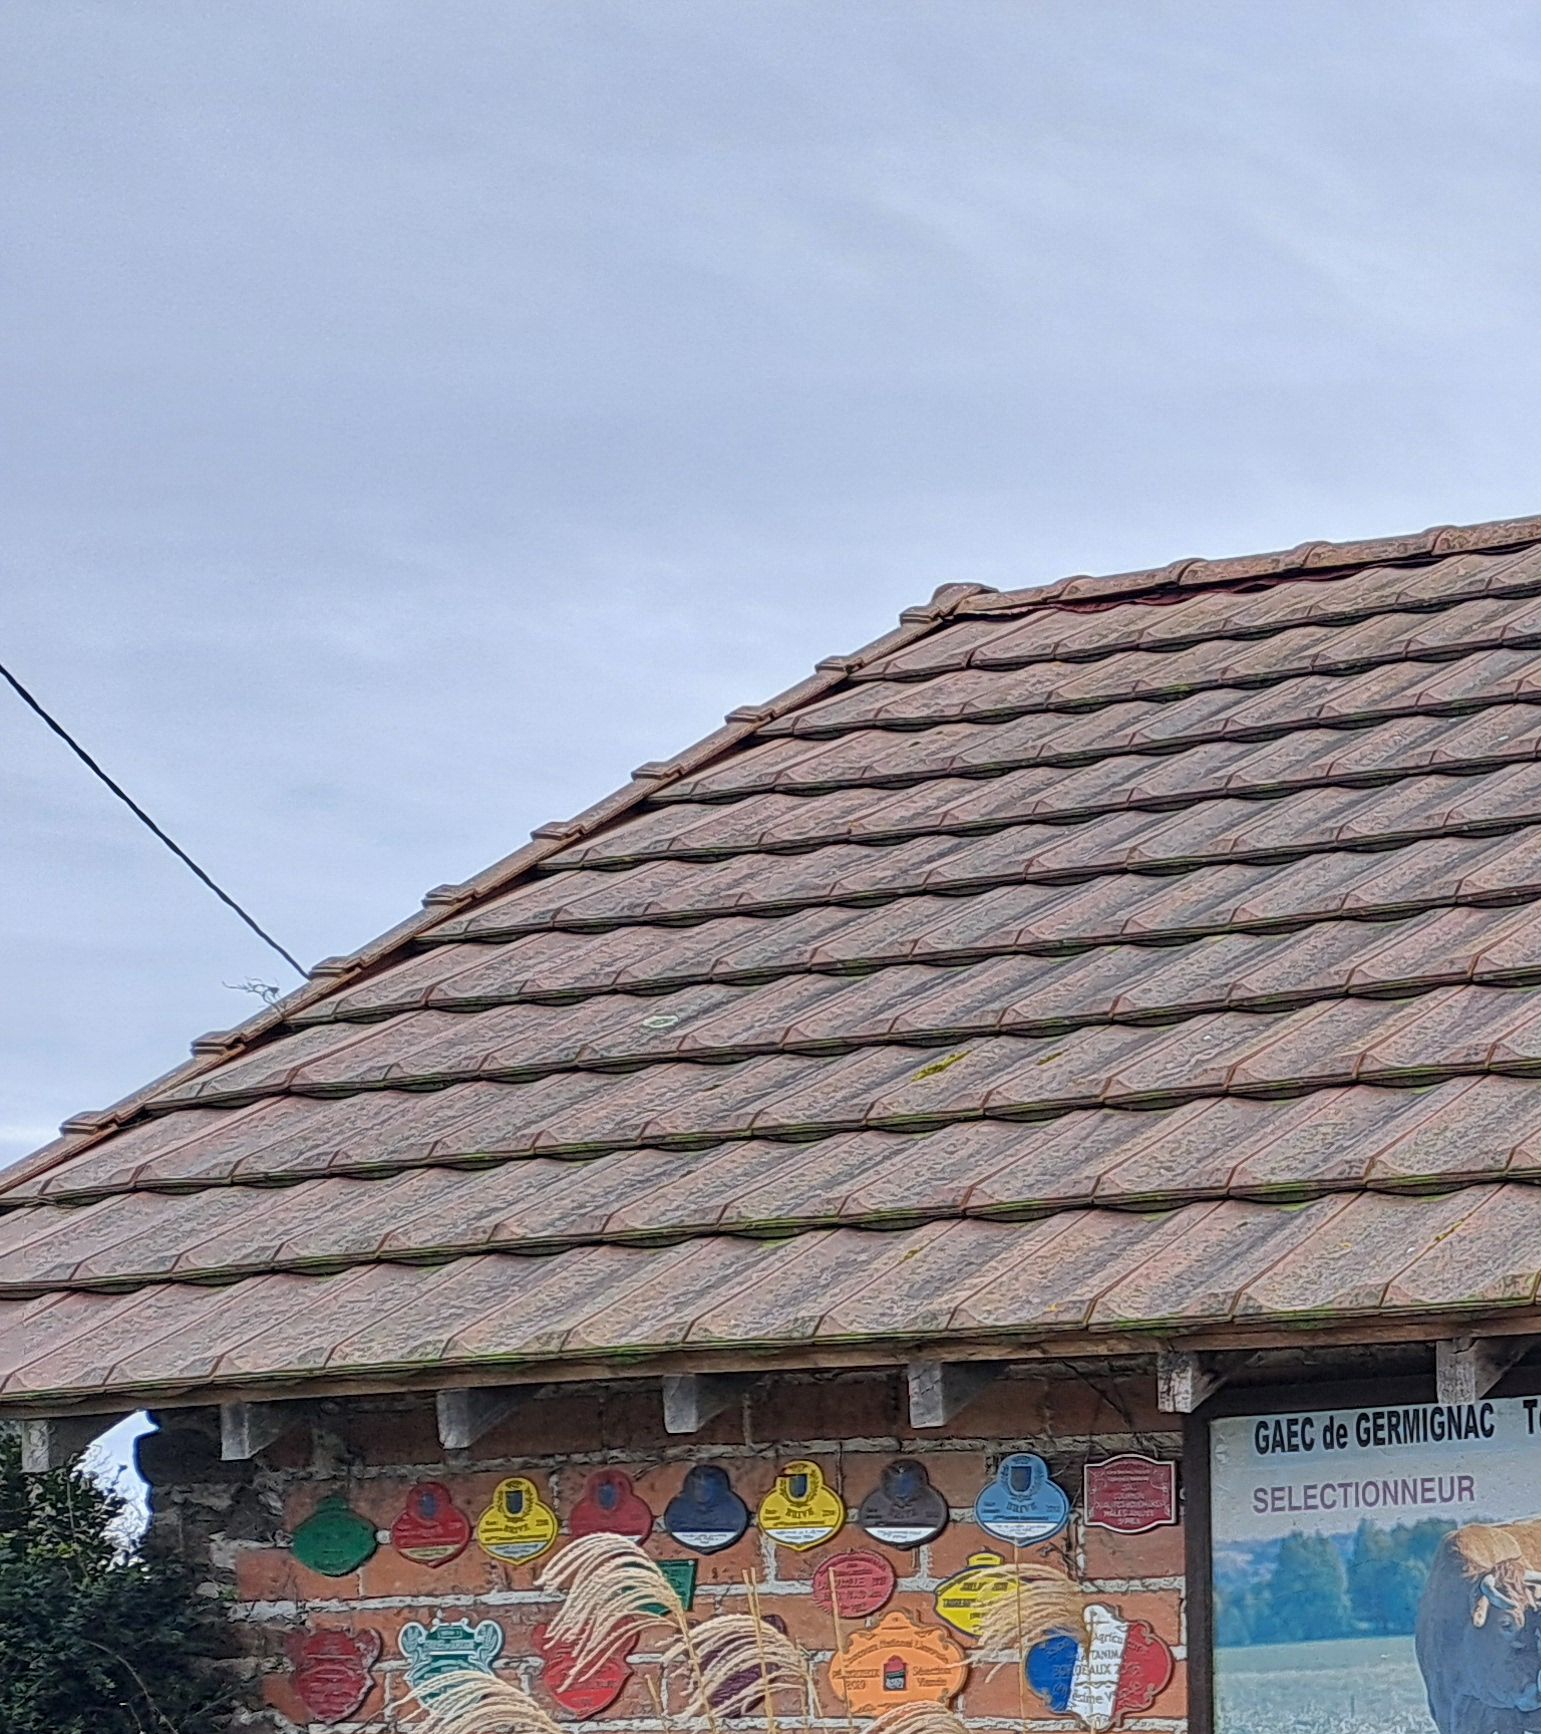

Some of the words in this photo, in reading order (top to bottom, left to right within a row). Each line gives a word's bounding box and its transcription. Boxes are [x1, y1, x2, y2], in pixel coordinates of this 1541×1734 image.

[1254, 1418, 1314, 1455] GAEC
[1322, 1416, 1348, 1450] de
[1356, 1402, 1495, 1447] GERMIGNAC
[1253, 1475, 1475, 1514] SELECTIONNEUR
